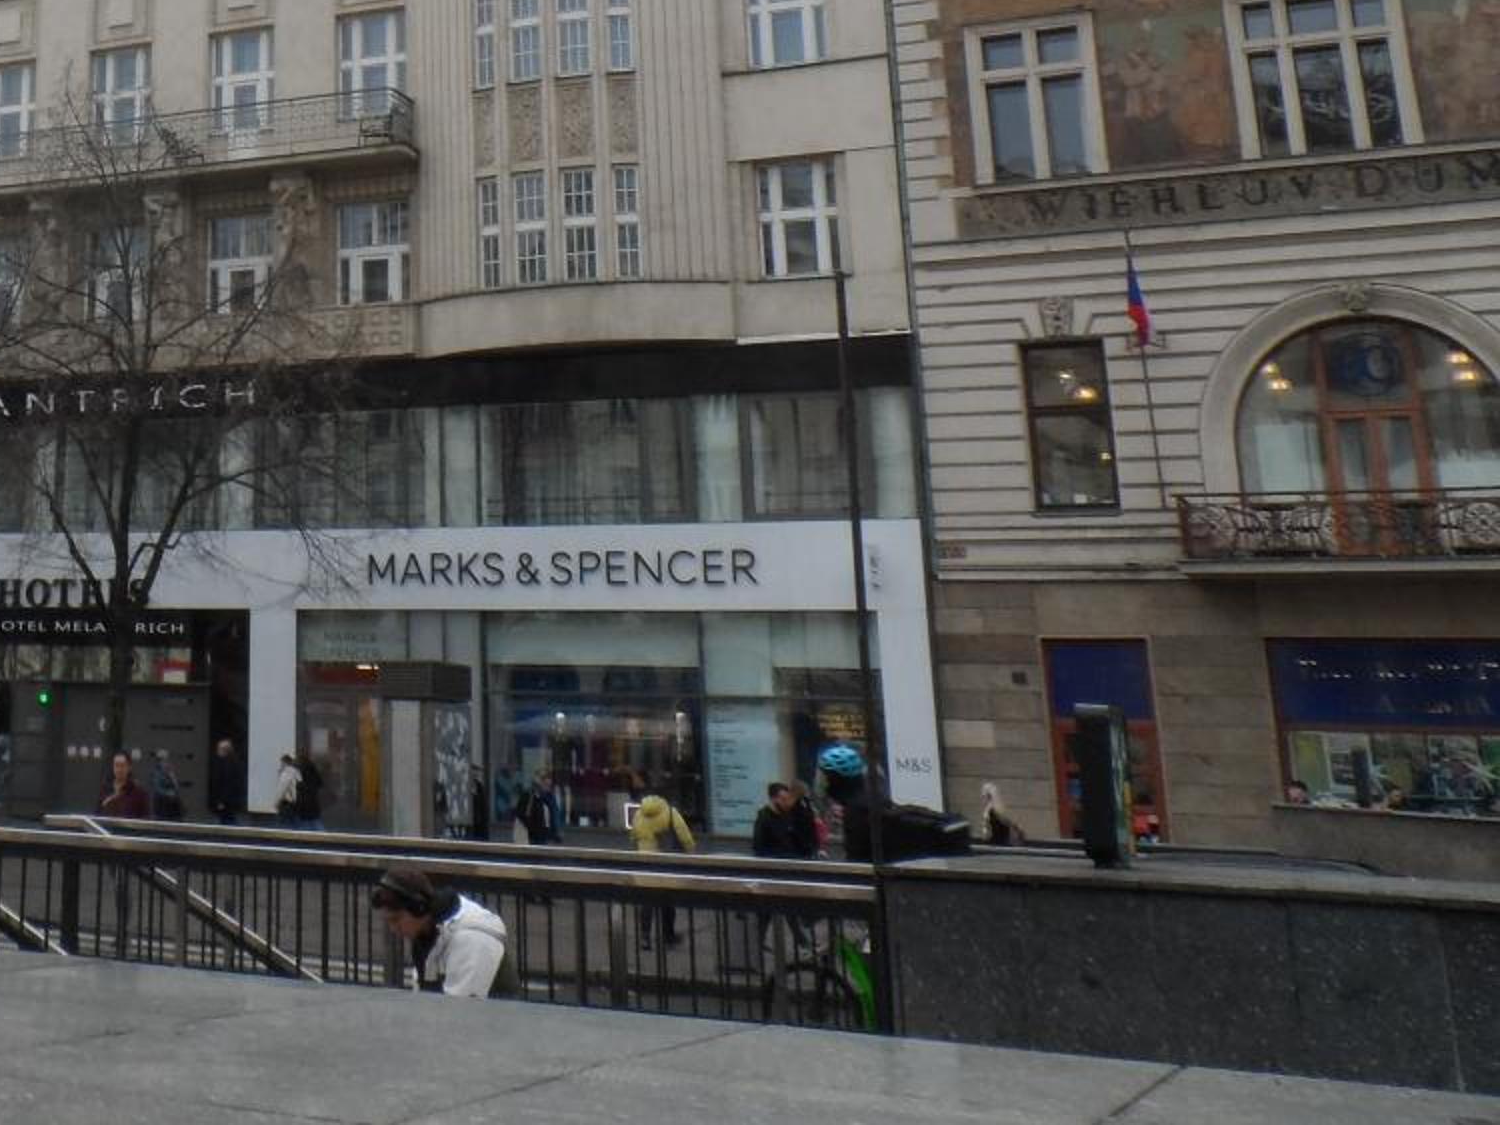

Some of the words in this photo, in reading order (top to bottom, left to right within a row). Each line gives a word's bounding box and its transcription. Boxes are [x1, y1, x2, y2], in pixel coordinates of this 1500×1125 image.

[367, 552, 504, 586] MARKS
[515, 551, 542, 586] &
[550, 549, 759, 586] SPENCER
[54, 620, 185, 635] MELARICH
